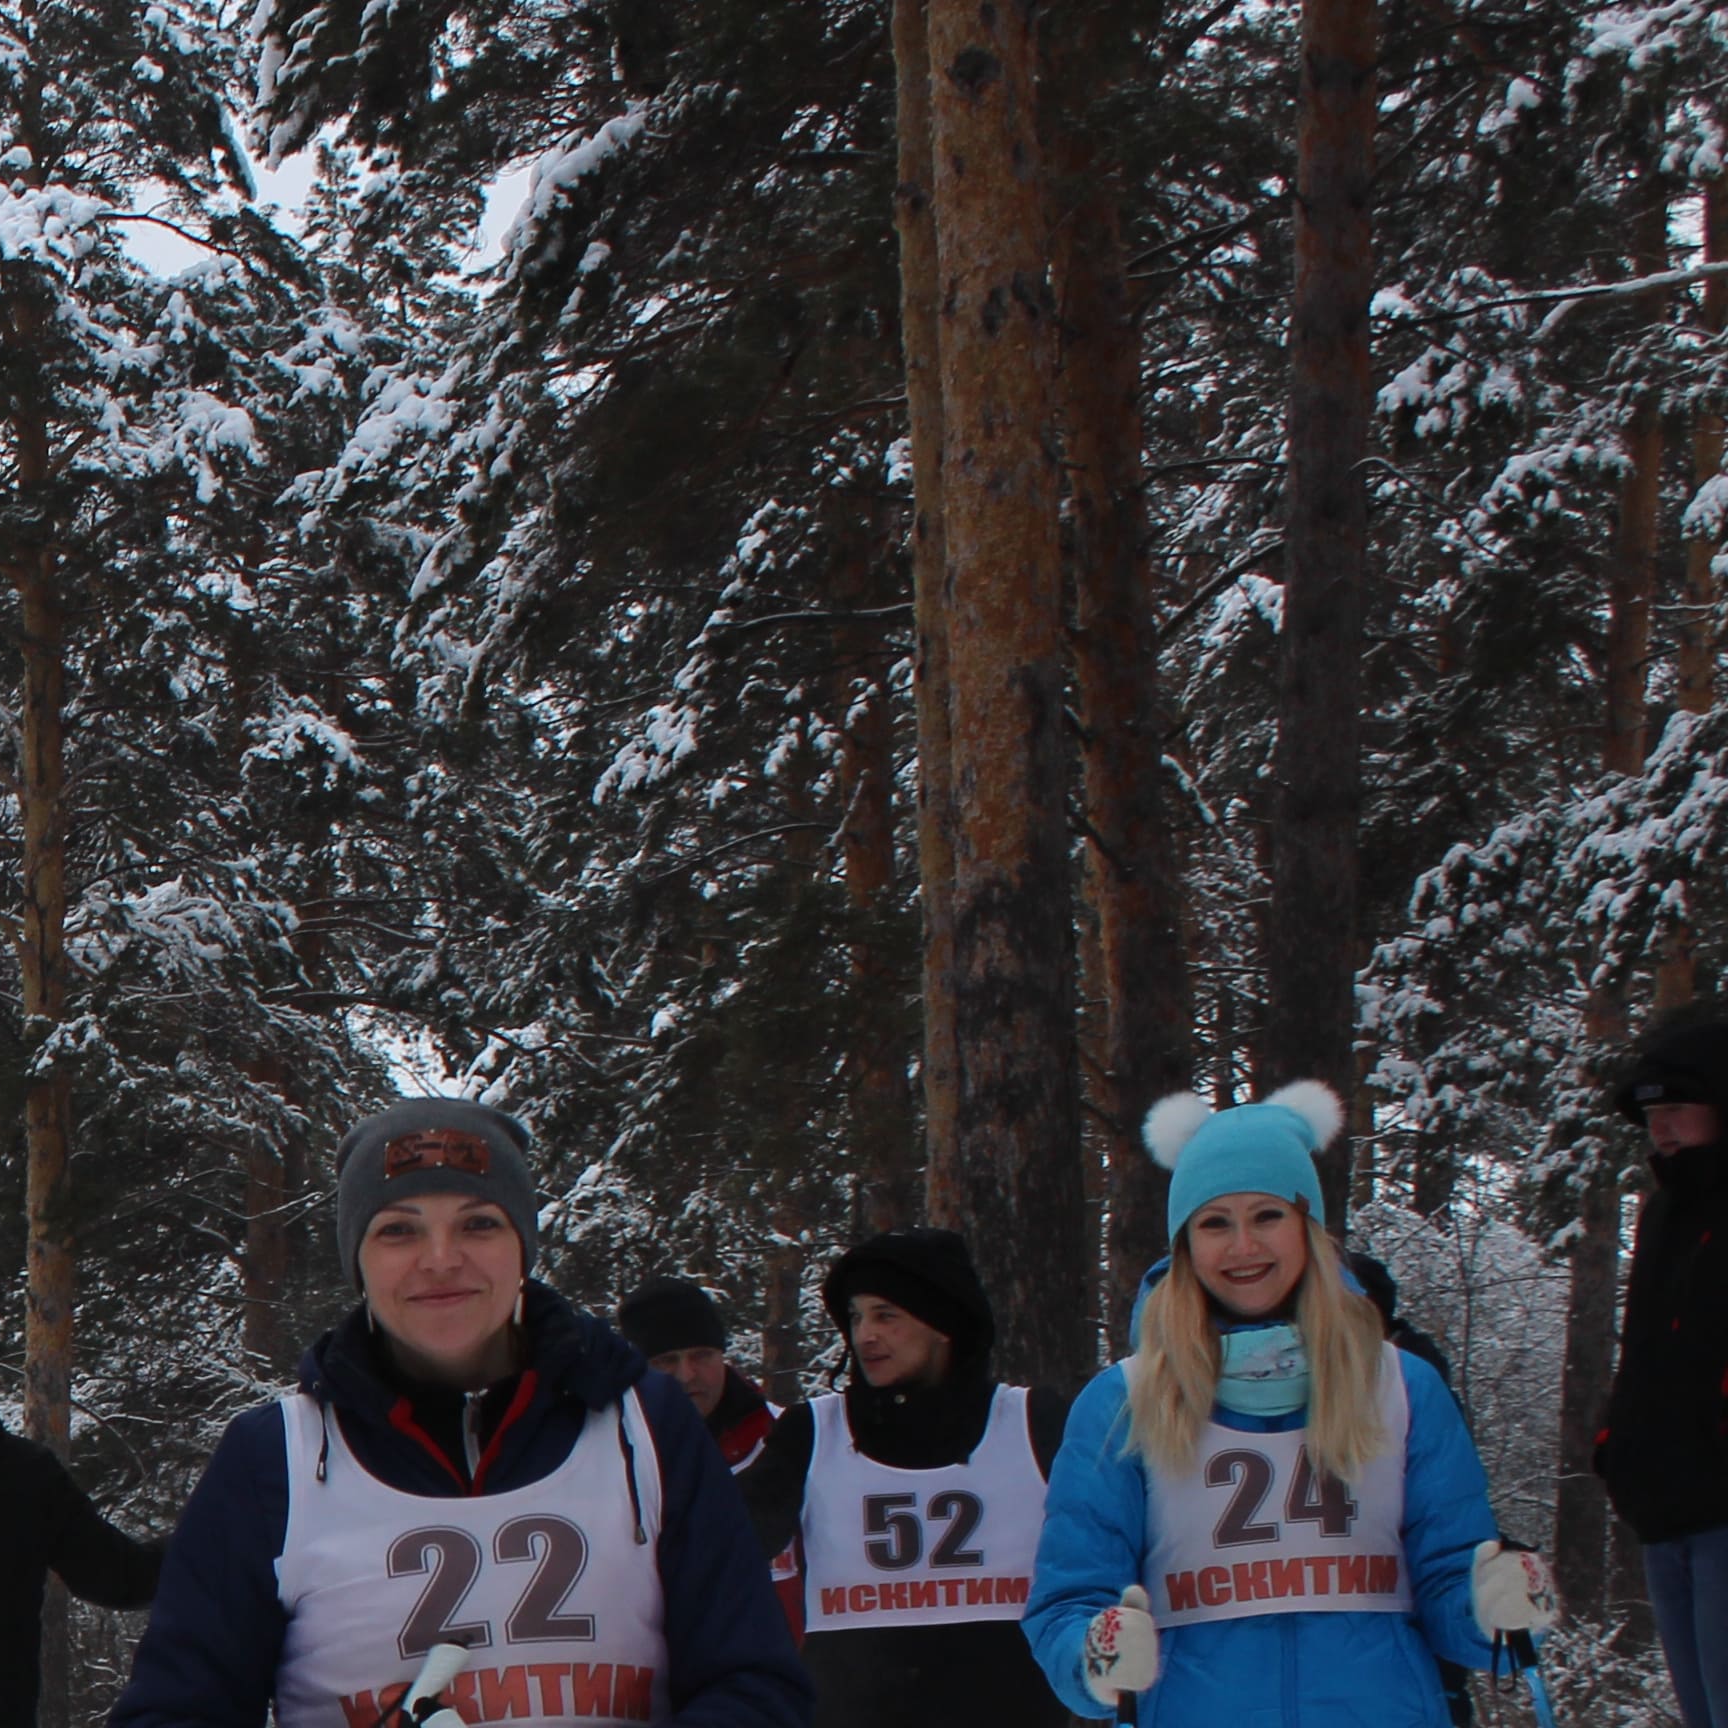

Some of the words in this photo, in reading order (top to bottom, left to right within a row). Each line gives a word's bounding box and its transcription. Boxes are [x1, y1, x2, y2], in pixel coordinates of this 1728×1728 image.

[863, 1489, 984, 1572] 52
[1204, 1444, 1358, 1549] 24
[387, 1513, 595, 1660] 22
[820, 1576, 1031, 1616] ИСКИТИМ
[1166, 1554, 1399, 1612] ИСКИТИМ
